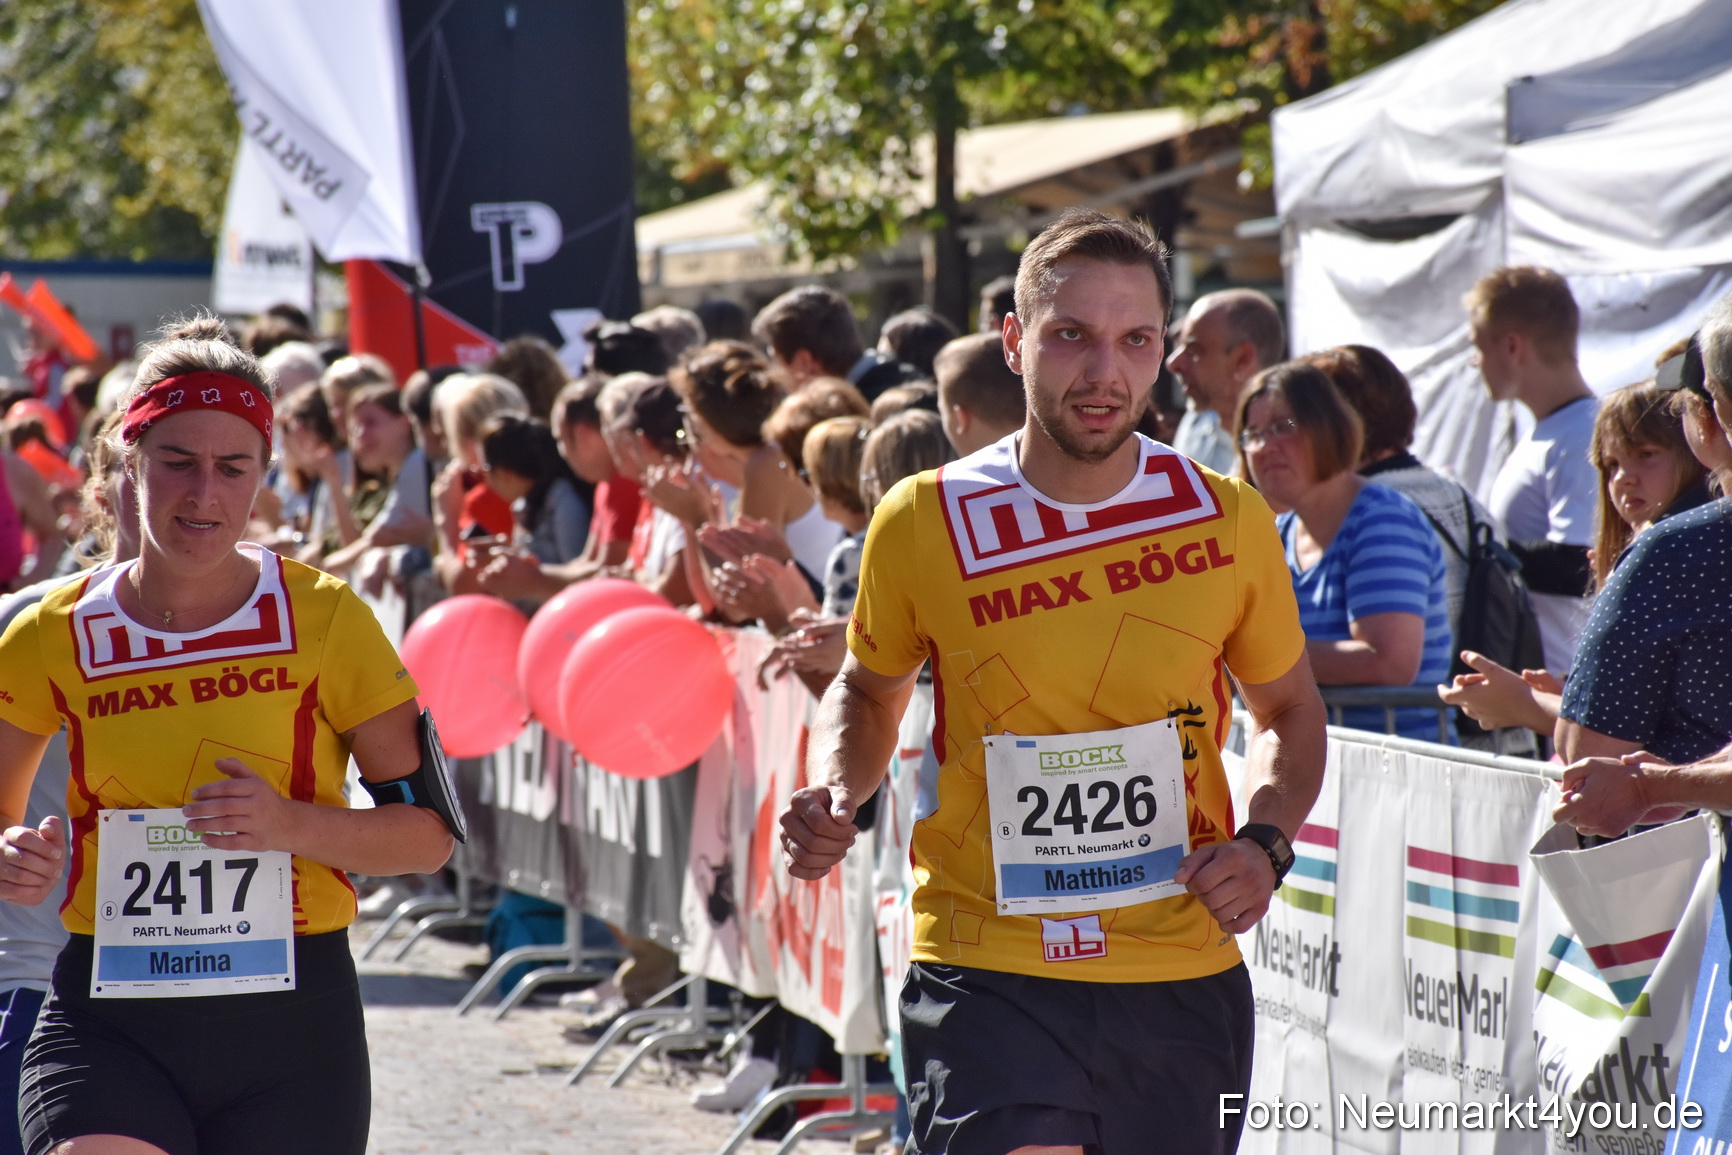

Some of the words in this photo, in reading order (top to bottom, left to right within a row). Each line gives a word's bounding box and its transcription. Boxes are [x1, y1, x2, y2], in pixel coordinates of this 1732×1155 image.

[252, 109, 343, 202] PARTL
[968, 571, 1093, 628] MAX
[1104, 537, 1235, 595] BÖGL
[87, 682, 179, 720] MAX
[190, 666, 298, 704] BÖGL
[1039, 744, 1126, 770] BOCK
[1078, 766, 1097, 774] smart
[1098, 763, 1128, 773] concepts
[1017, 774, 1157, 837] 2426
[147, 825, 228, 845] BOC
[148, 844, 170, 852] inspired
[171, 844, 179, 852] by
[180, 844, 200, 852] smart
[1035, 845, 1075, 856] PARTL
[1077, 839, 1134, 855] Neumarkt
[122, 857, 259, 917] 2417
[1044, 864, 1146, 891] Matthias
[133, 926, 171, 937] PARTL
[174, 924, 232, 937] Neumarkt
[150, 950, 231, 975] Marina
